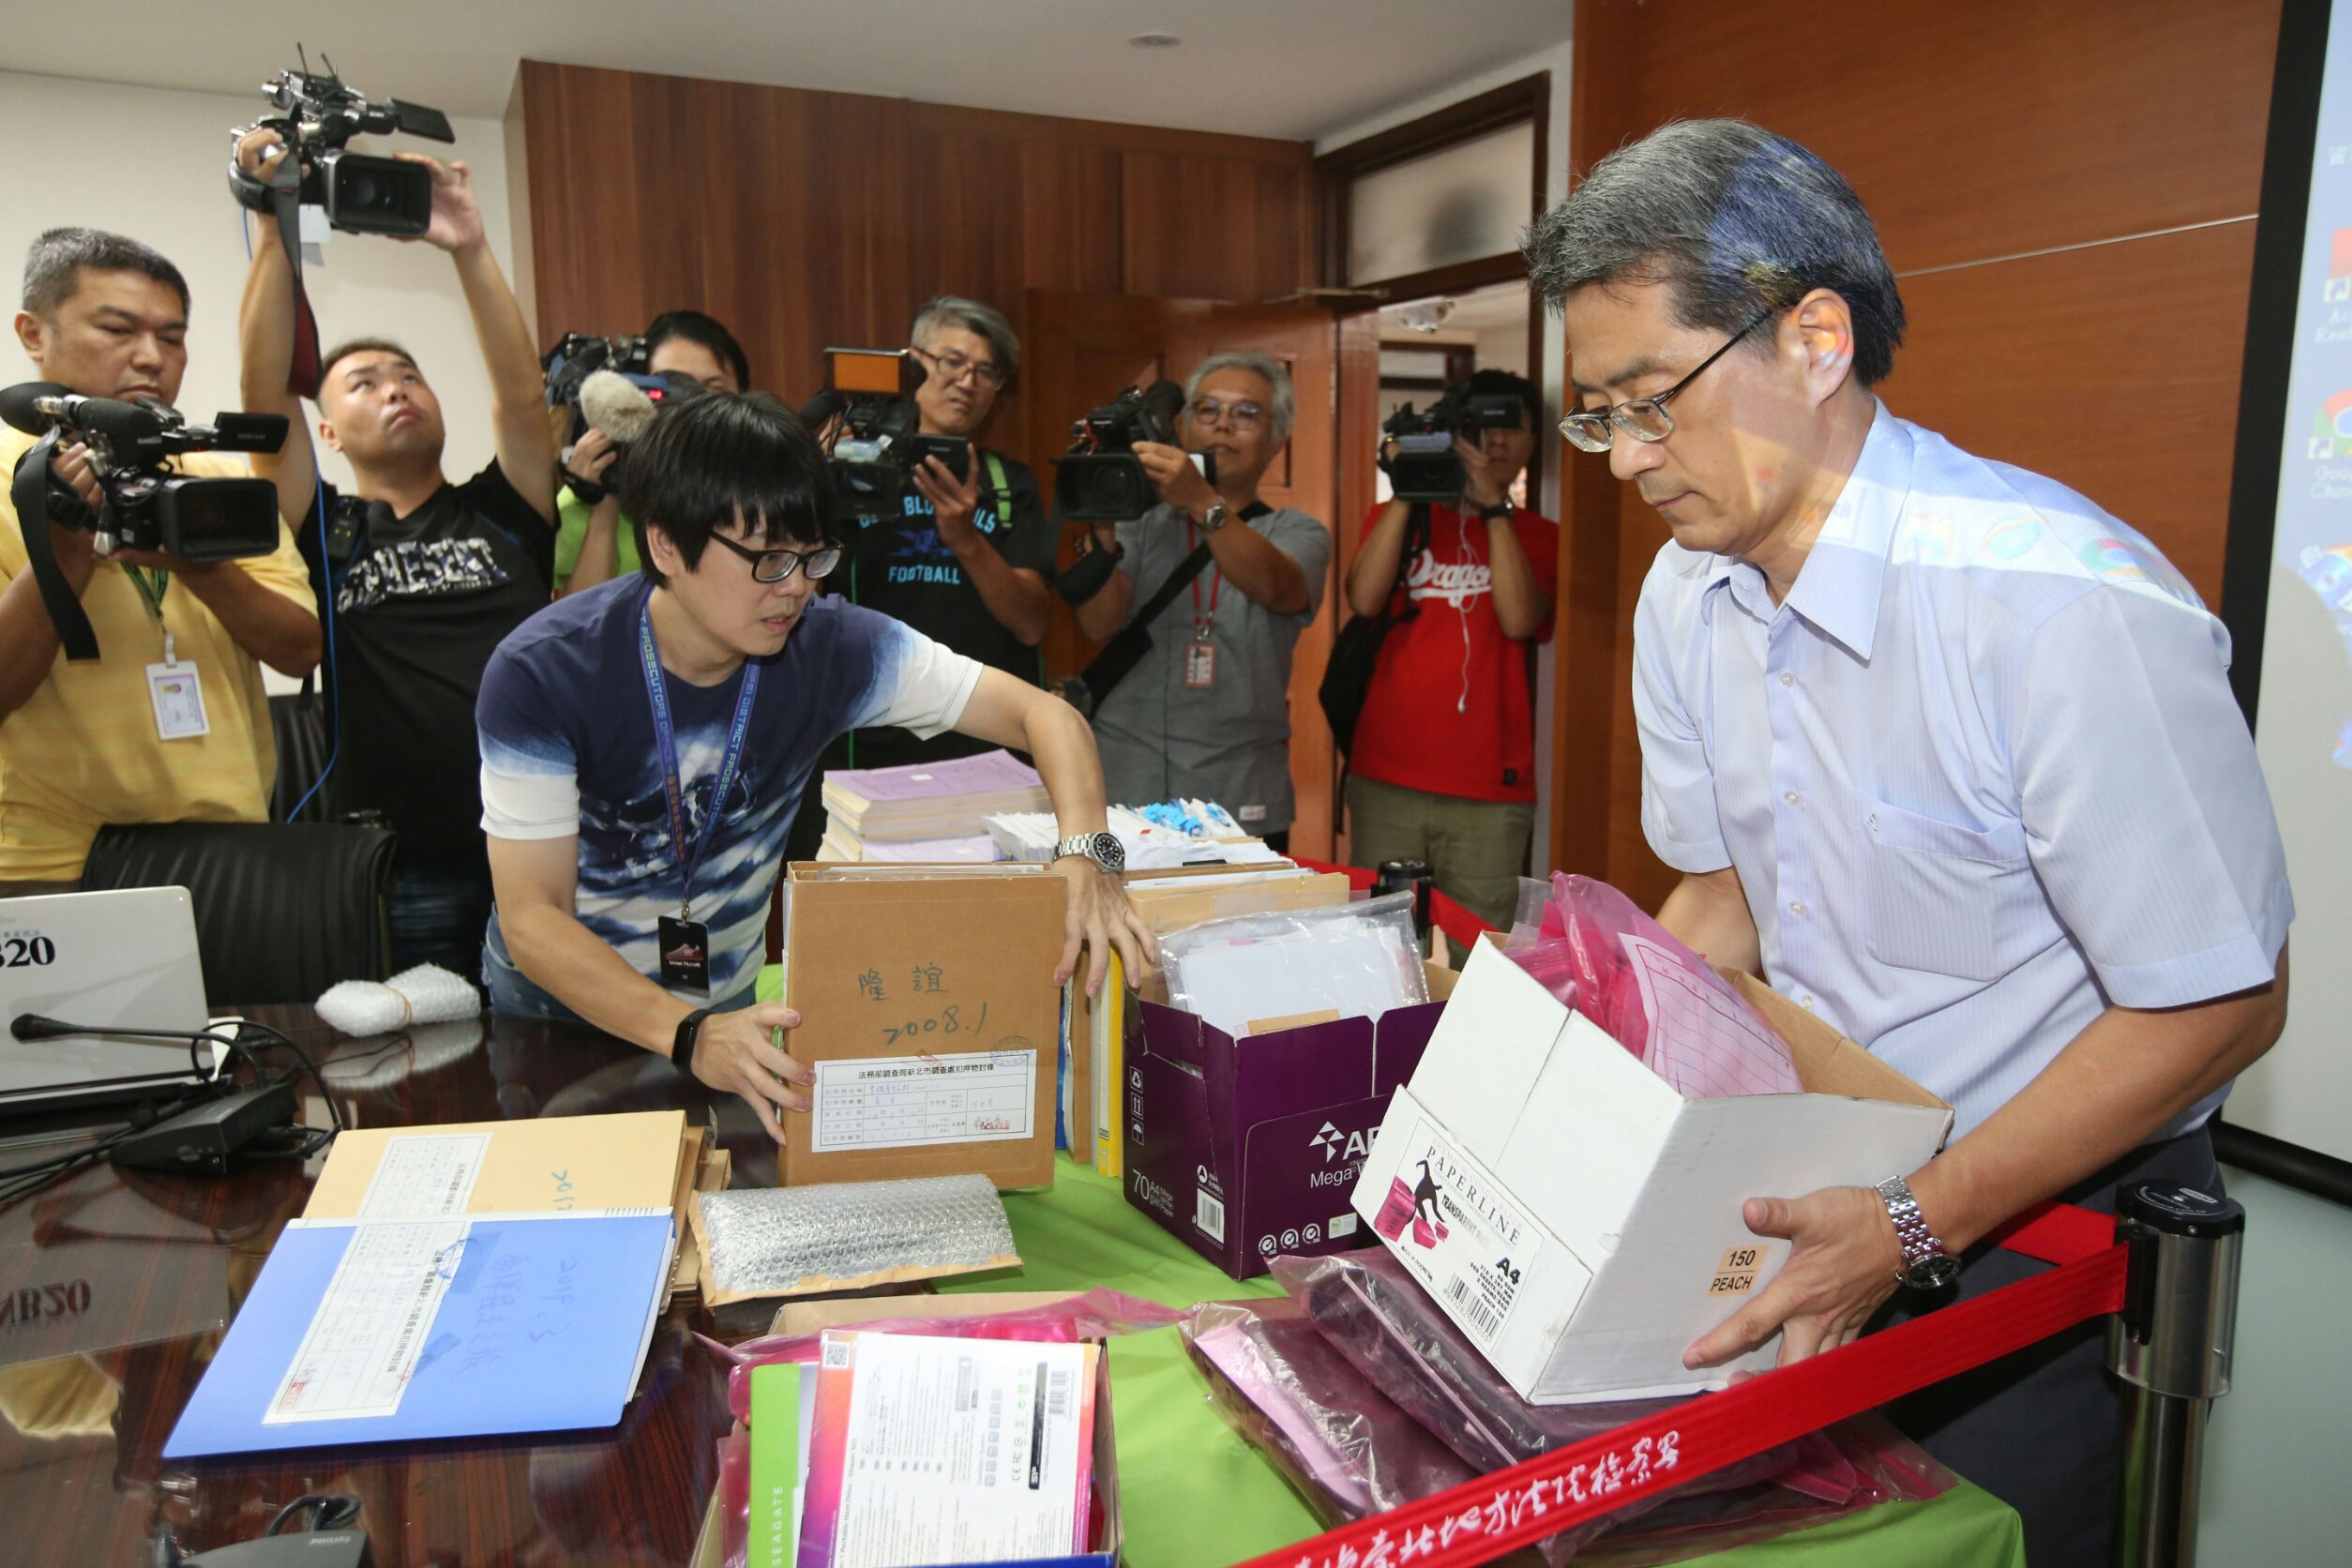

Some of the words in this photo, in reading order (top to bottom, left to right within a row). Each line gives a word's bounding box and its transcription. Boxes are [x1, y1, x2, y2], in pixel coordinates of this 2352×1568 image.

[888, 565, 960, 584] FOOTBALL
[1408, 549, 1491, 609] Drago
[0, 936, 55, 968] 20
[882, 1002, 988, 1045] 2008.1
[1132, 1168, 1150, 1200] 70
[1311, 1167, 1352, 1188] Mega
[1426, 1145, 1520, 1245] PAPERLINE
[1441, 1194, 1477, 1239] TRANSPARENT
[1496, 1257, 1520, 1285] A4
[1729, 1250, 1756, 1267] 150
[1711, 1275, 1753, 1291] PEACH
[1482, 1292, 1495, 1309] PEACH
[310, 1535, 352, 1545] PHILIPS
[773, 1485, 783, 1565] SEAGATE
